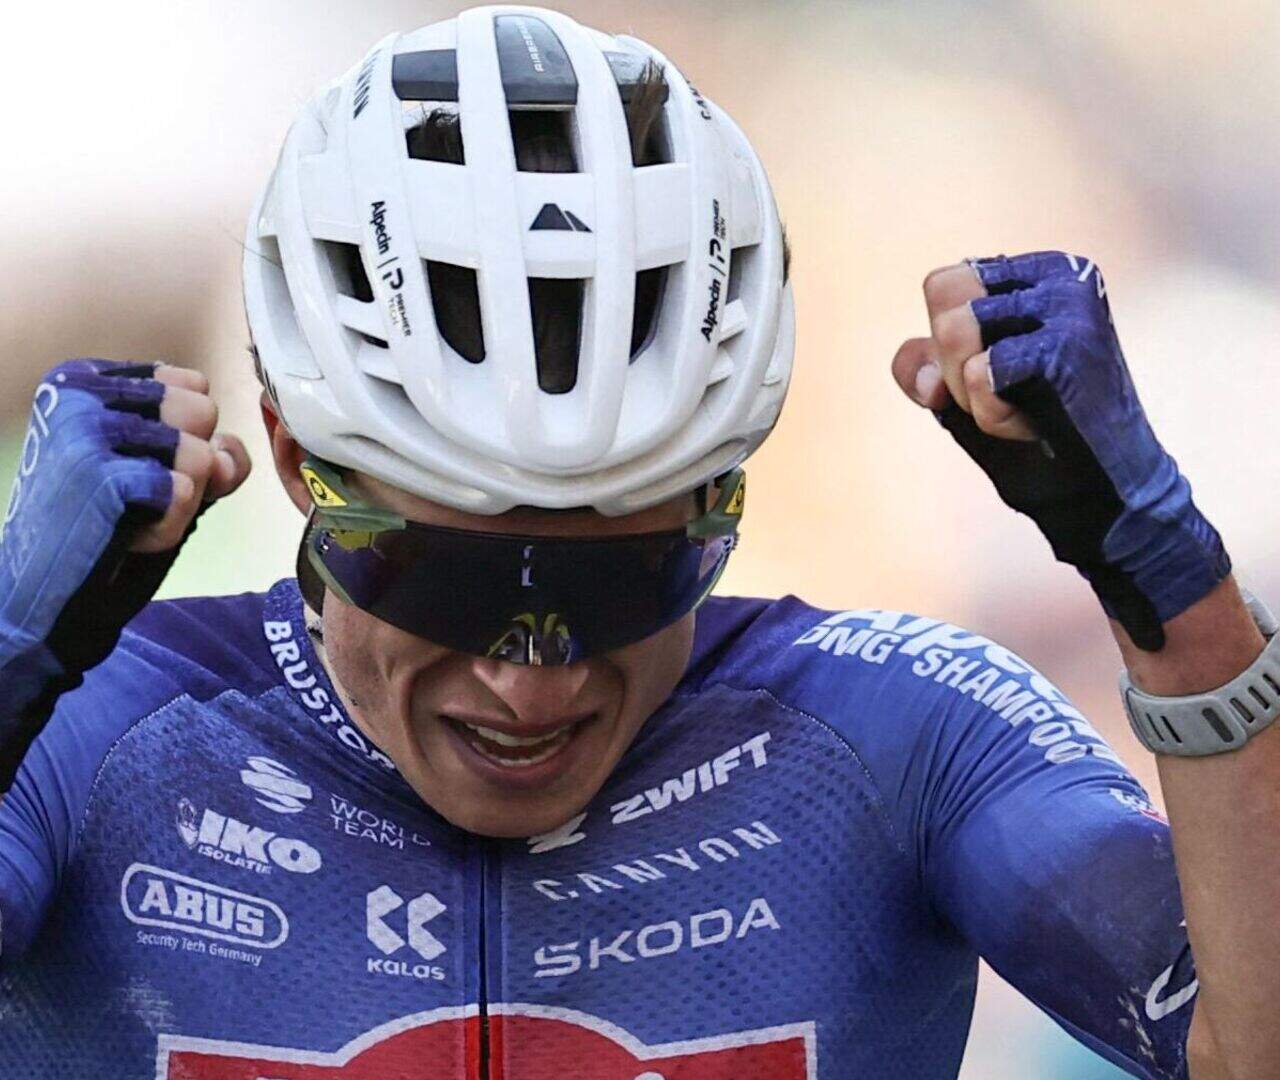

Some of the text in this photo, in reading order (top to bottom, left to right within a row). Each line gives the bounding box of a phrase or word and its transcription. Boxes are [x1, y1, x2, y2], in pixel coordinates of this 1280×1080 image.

[370, 201, 392, 255] Alpecin
[700, 278, 721, 343] Alpecin
[793, 625, 1087, 765] DMG SHAMPOO
[610, 731, 771, 825] ZWIFT
[198, 808, 322, 874] IKO
[330, 813, 404, 850] TEAM
[533, 820, 782, 901] CANYON
[139, 879, 265, 937] ABUS
[136, 930, 263, 966] Security Tech Germany
